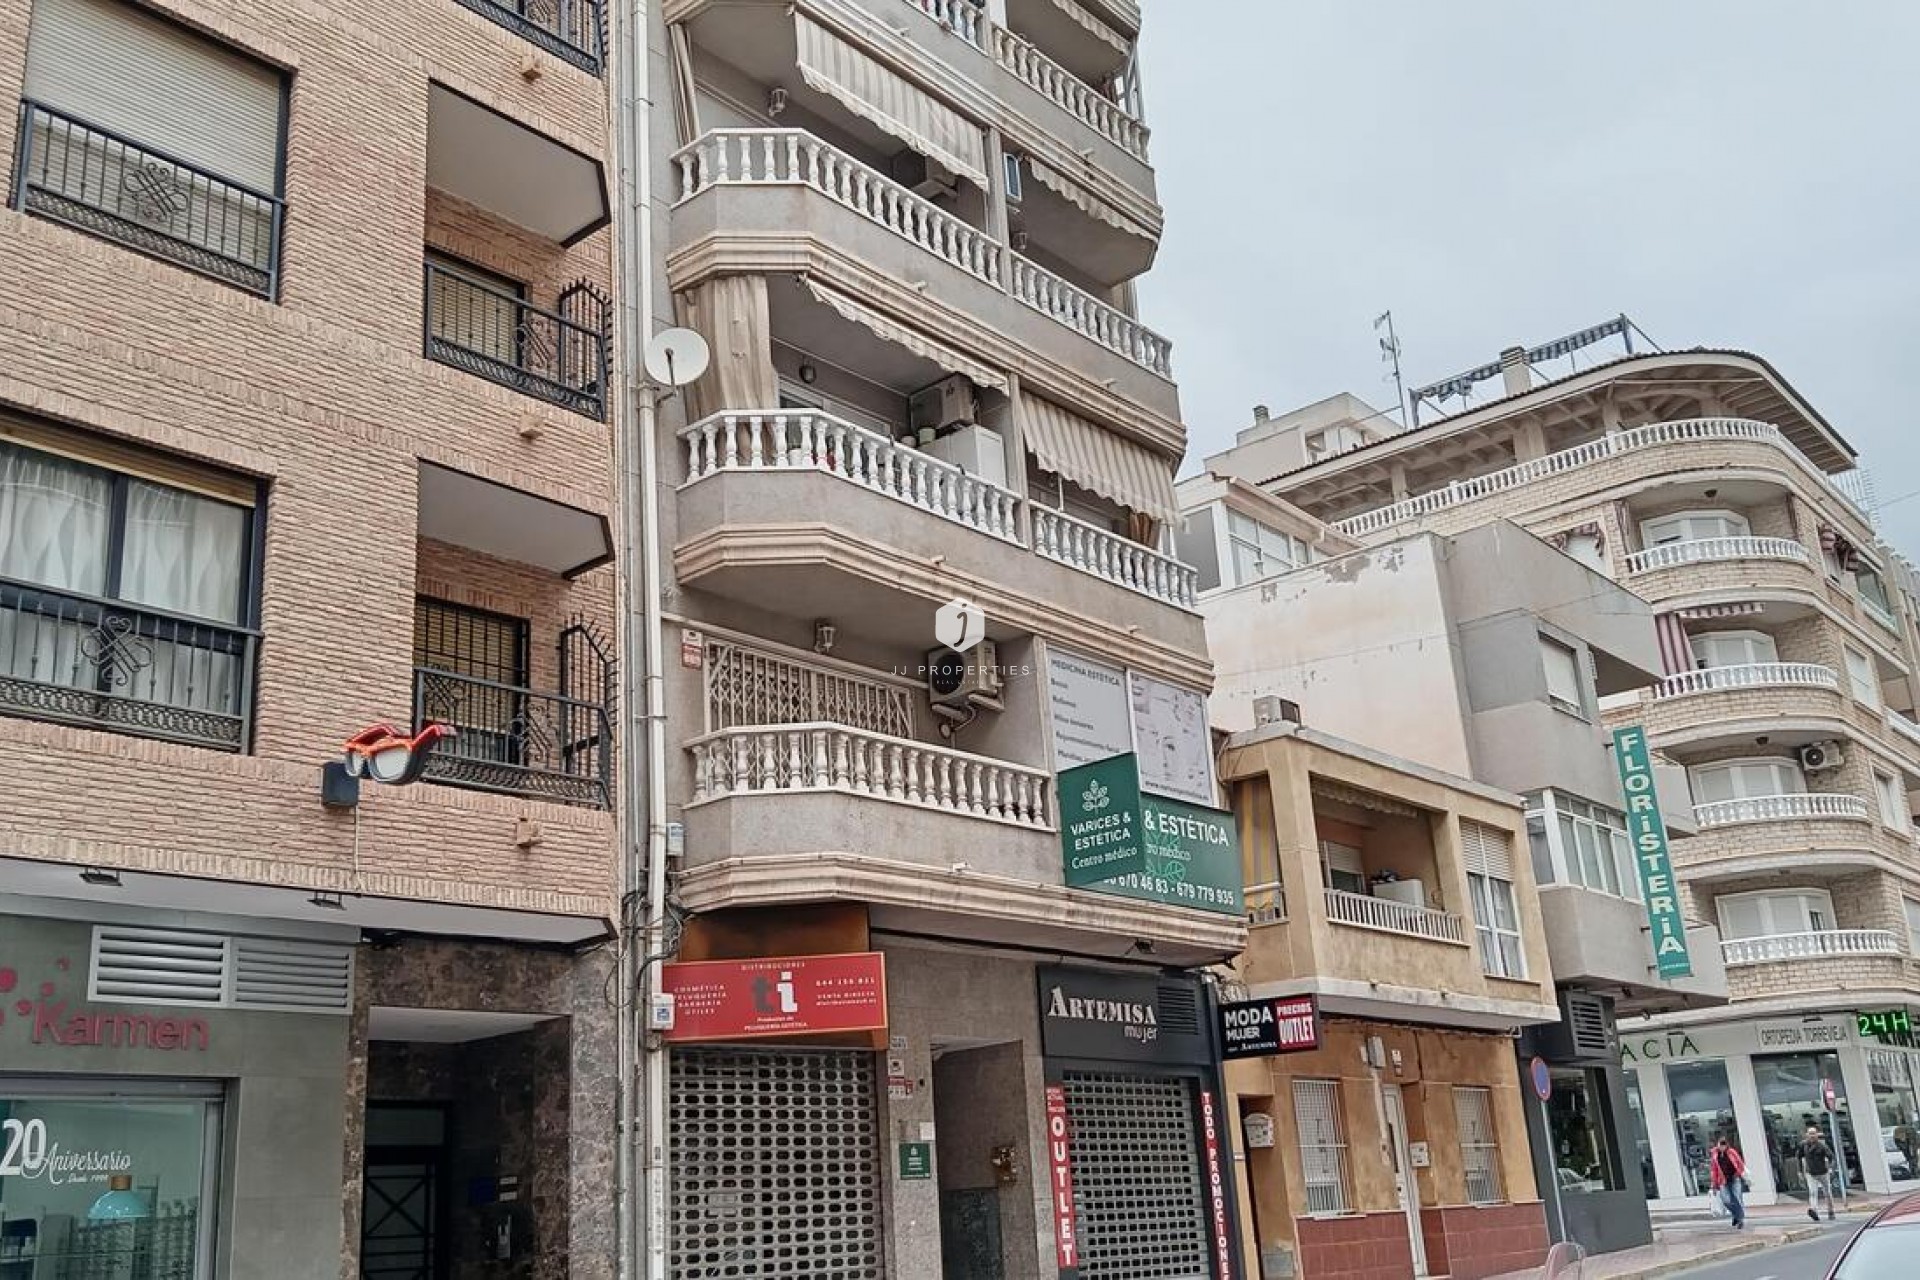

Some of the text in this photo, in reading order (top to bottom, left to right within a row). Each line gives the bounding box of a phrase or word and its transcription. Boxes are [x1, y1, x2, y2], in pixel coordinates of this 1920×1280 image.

[1070, 811, 1132, 836] VARICES &
[1144, 809, 1230, 847] & ESTÉTICA
[1071, 854, 1103, 870] Centro
[1048, 986, 1157, 1025] ARTEMISA
[1224, 1006, 1274, 1028] MODA
[33, 1001, 210, 1051] Karmen
[1124, 1025, 1157, 1043] mujer
[1226, 1026, 1260, 1042] MUJER
[1278, 1015, 1315, 1044] OUTLET
[1203, 1092, 1215, 1139] TODO
[0, 1118, 131, 1185] 20 Aniversario
[1051, 1116, 1073, 1266] OUTLET
